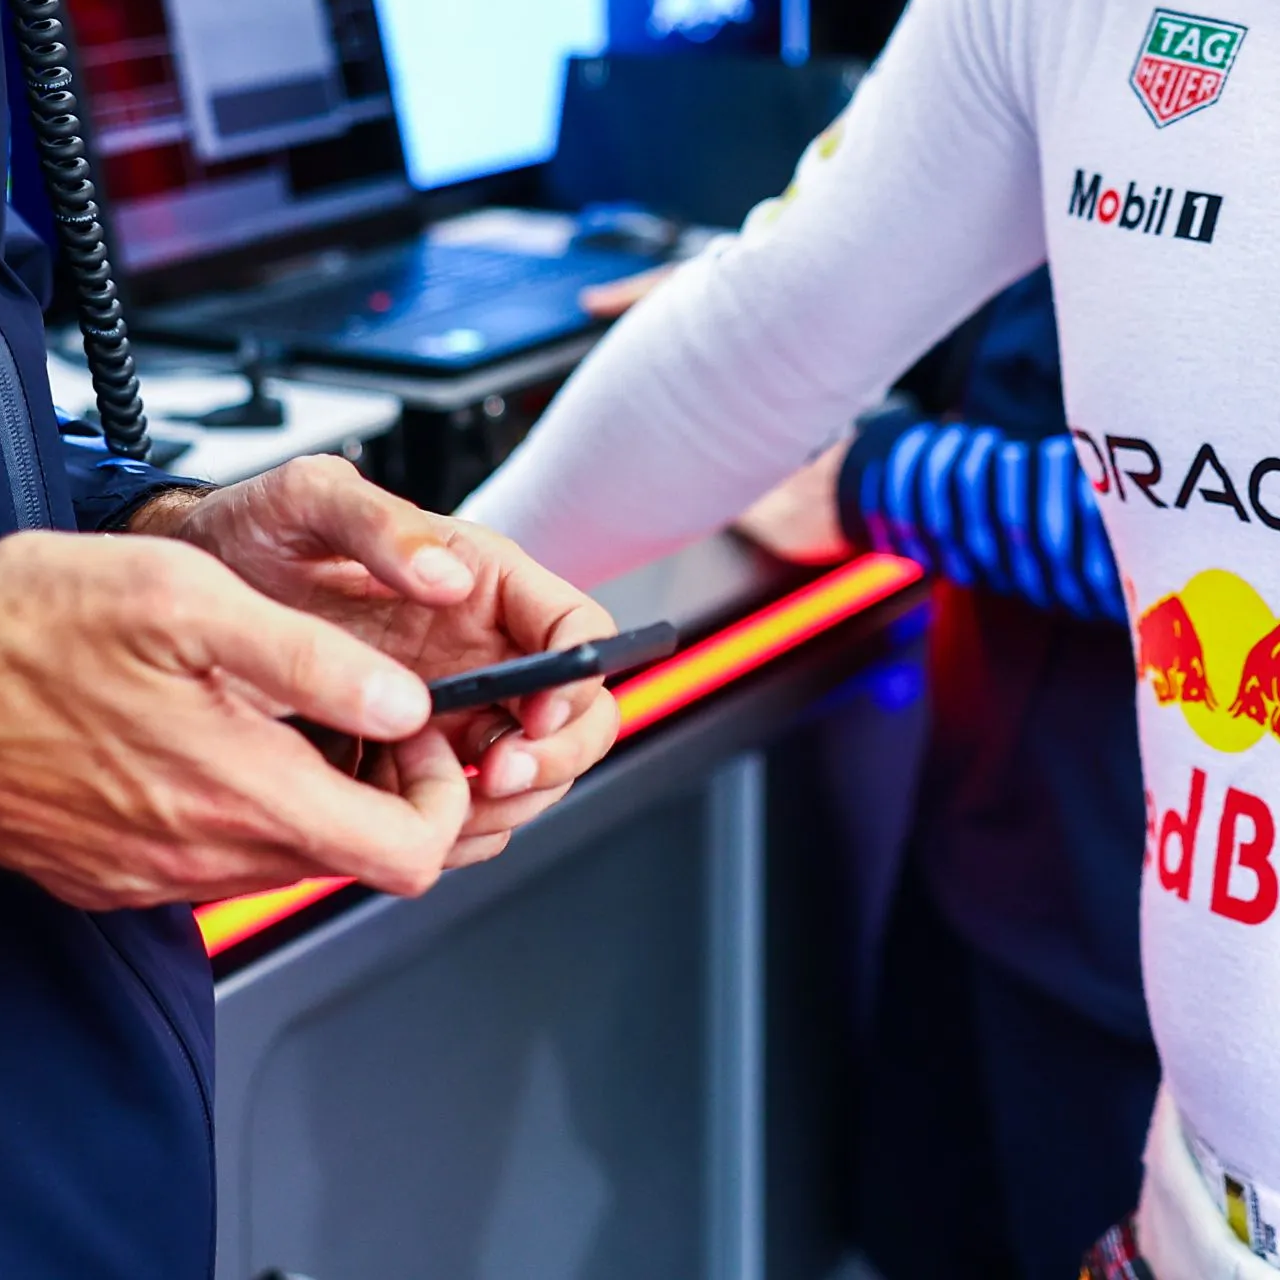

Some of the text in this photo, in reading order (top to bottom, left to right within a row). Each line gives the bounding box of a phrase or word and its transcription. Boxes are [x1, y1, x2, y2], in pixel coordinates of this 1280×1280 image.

[1160, 21, 1232, 64] TAG
[1140, 62, 1218, 115] HEUER
[1068, 170, 1208, 239] Mobil 1
